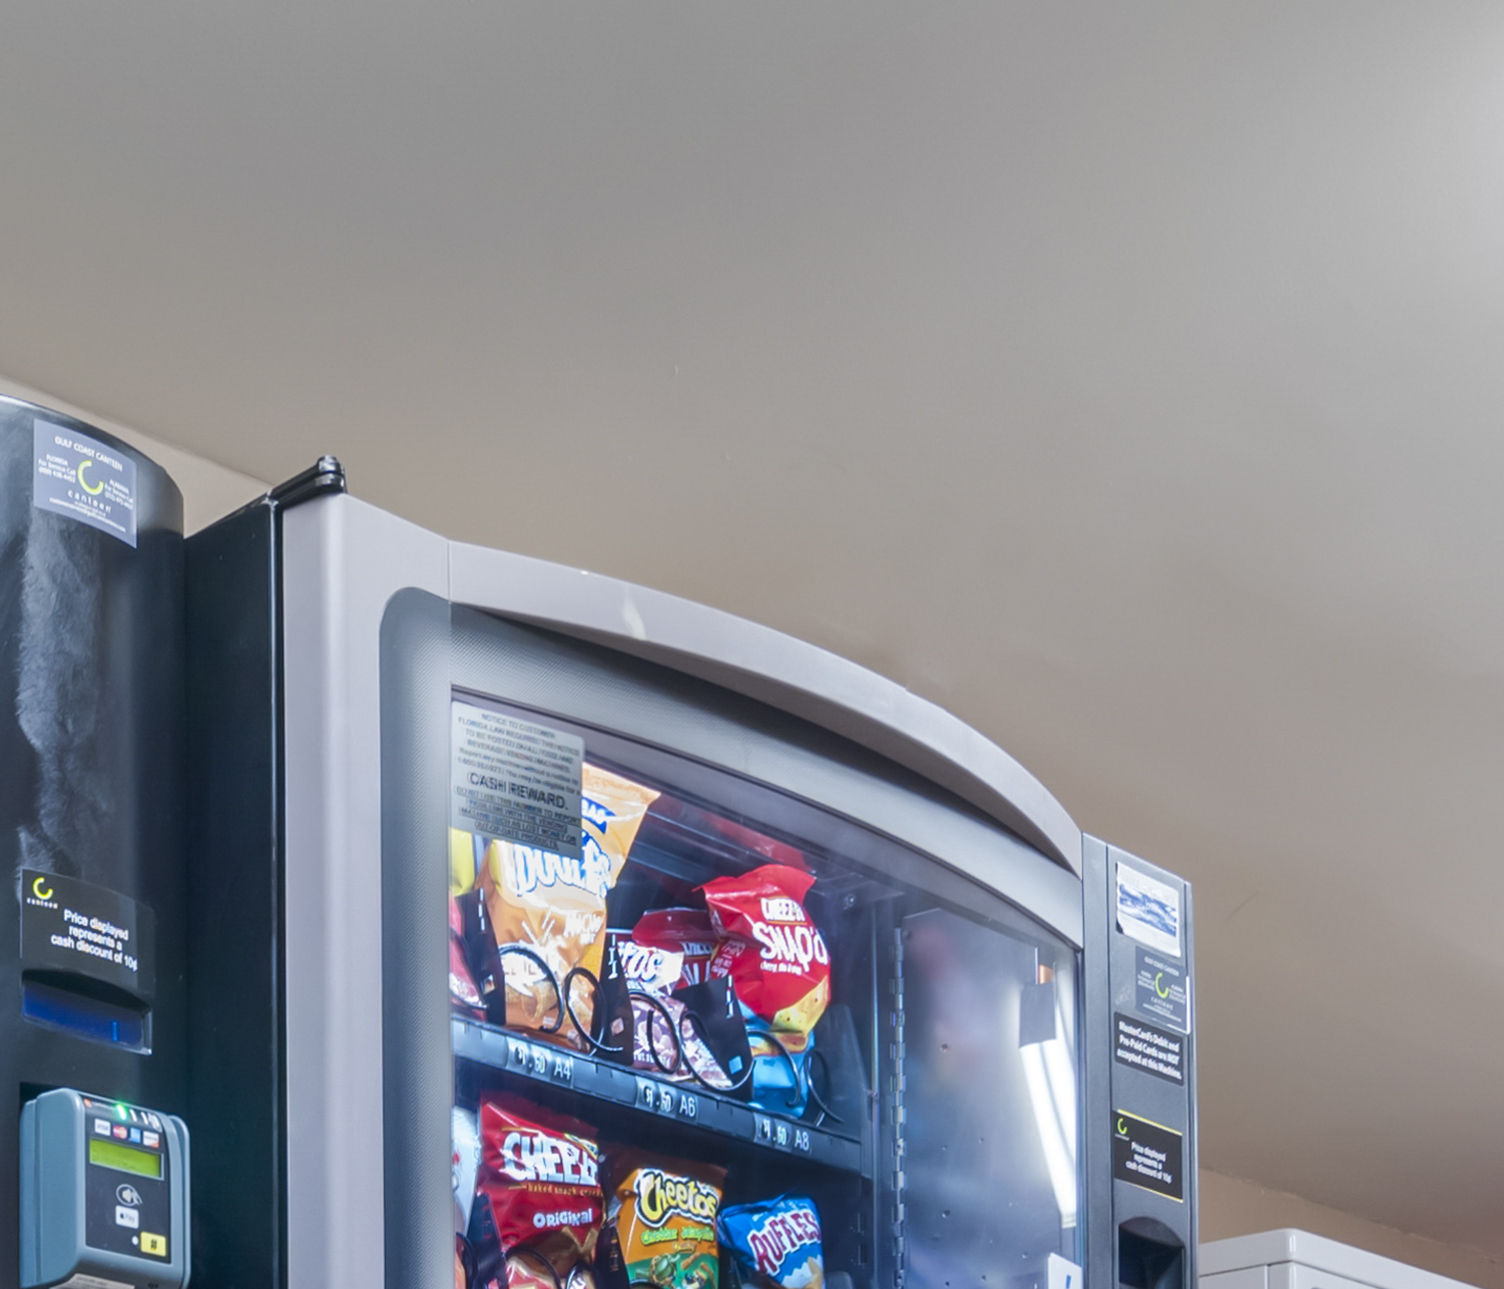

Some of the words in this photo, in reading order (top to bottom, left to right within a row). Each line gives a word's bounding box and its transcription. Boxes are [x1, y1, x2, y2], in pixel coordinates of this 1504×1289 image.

[67, 489, 111, 514] canteen
[467, 772, 507, 793] CASH
[63, 908, 88, 926] Price
[90, 917, 129, 941] displayed
[51, 934, 75, 949] cash
[76, 940, 113, 961] discount
[114, 952, 123, 964] of
[69, 925, 115, 948] represents
[116, 941, 123, 951] a
[1119, 1034, 1142, 1053] Pre-Paid
[1143, 1042, 1158, 1057] Cards
[554, 1058, 571, 1080] A4
[679, 1095, 695, 1117] A6
[795, 1129, 809, 1151] A8
[636, 1170, 719, 1222] Cheetos
[748, 1209, 822, 1273] RUFFLES
